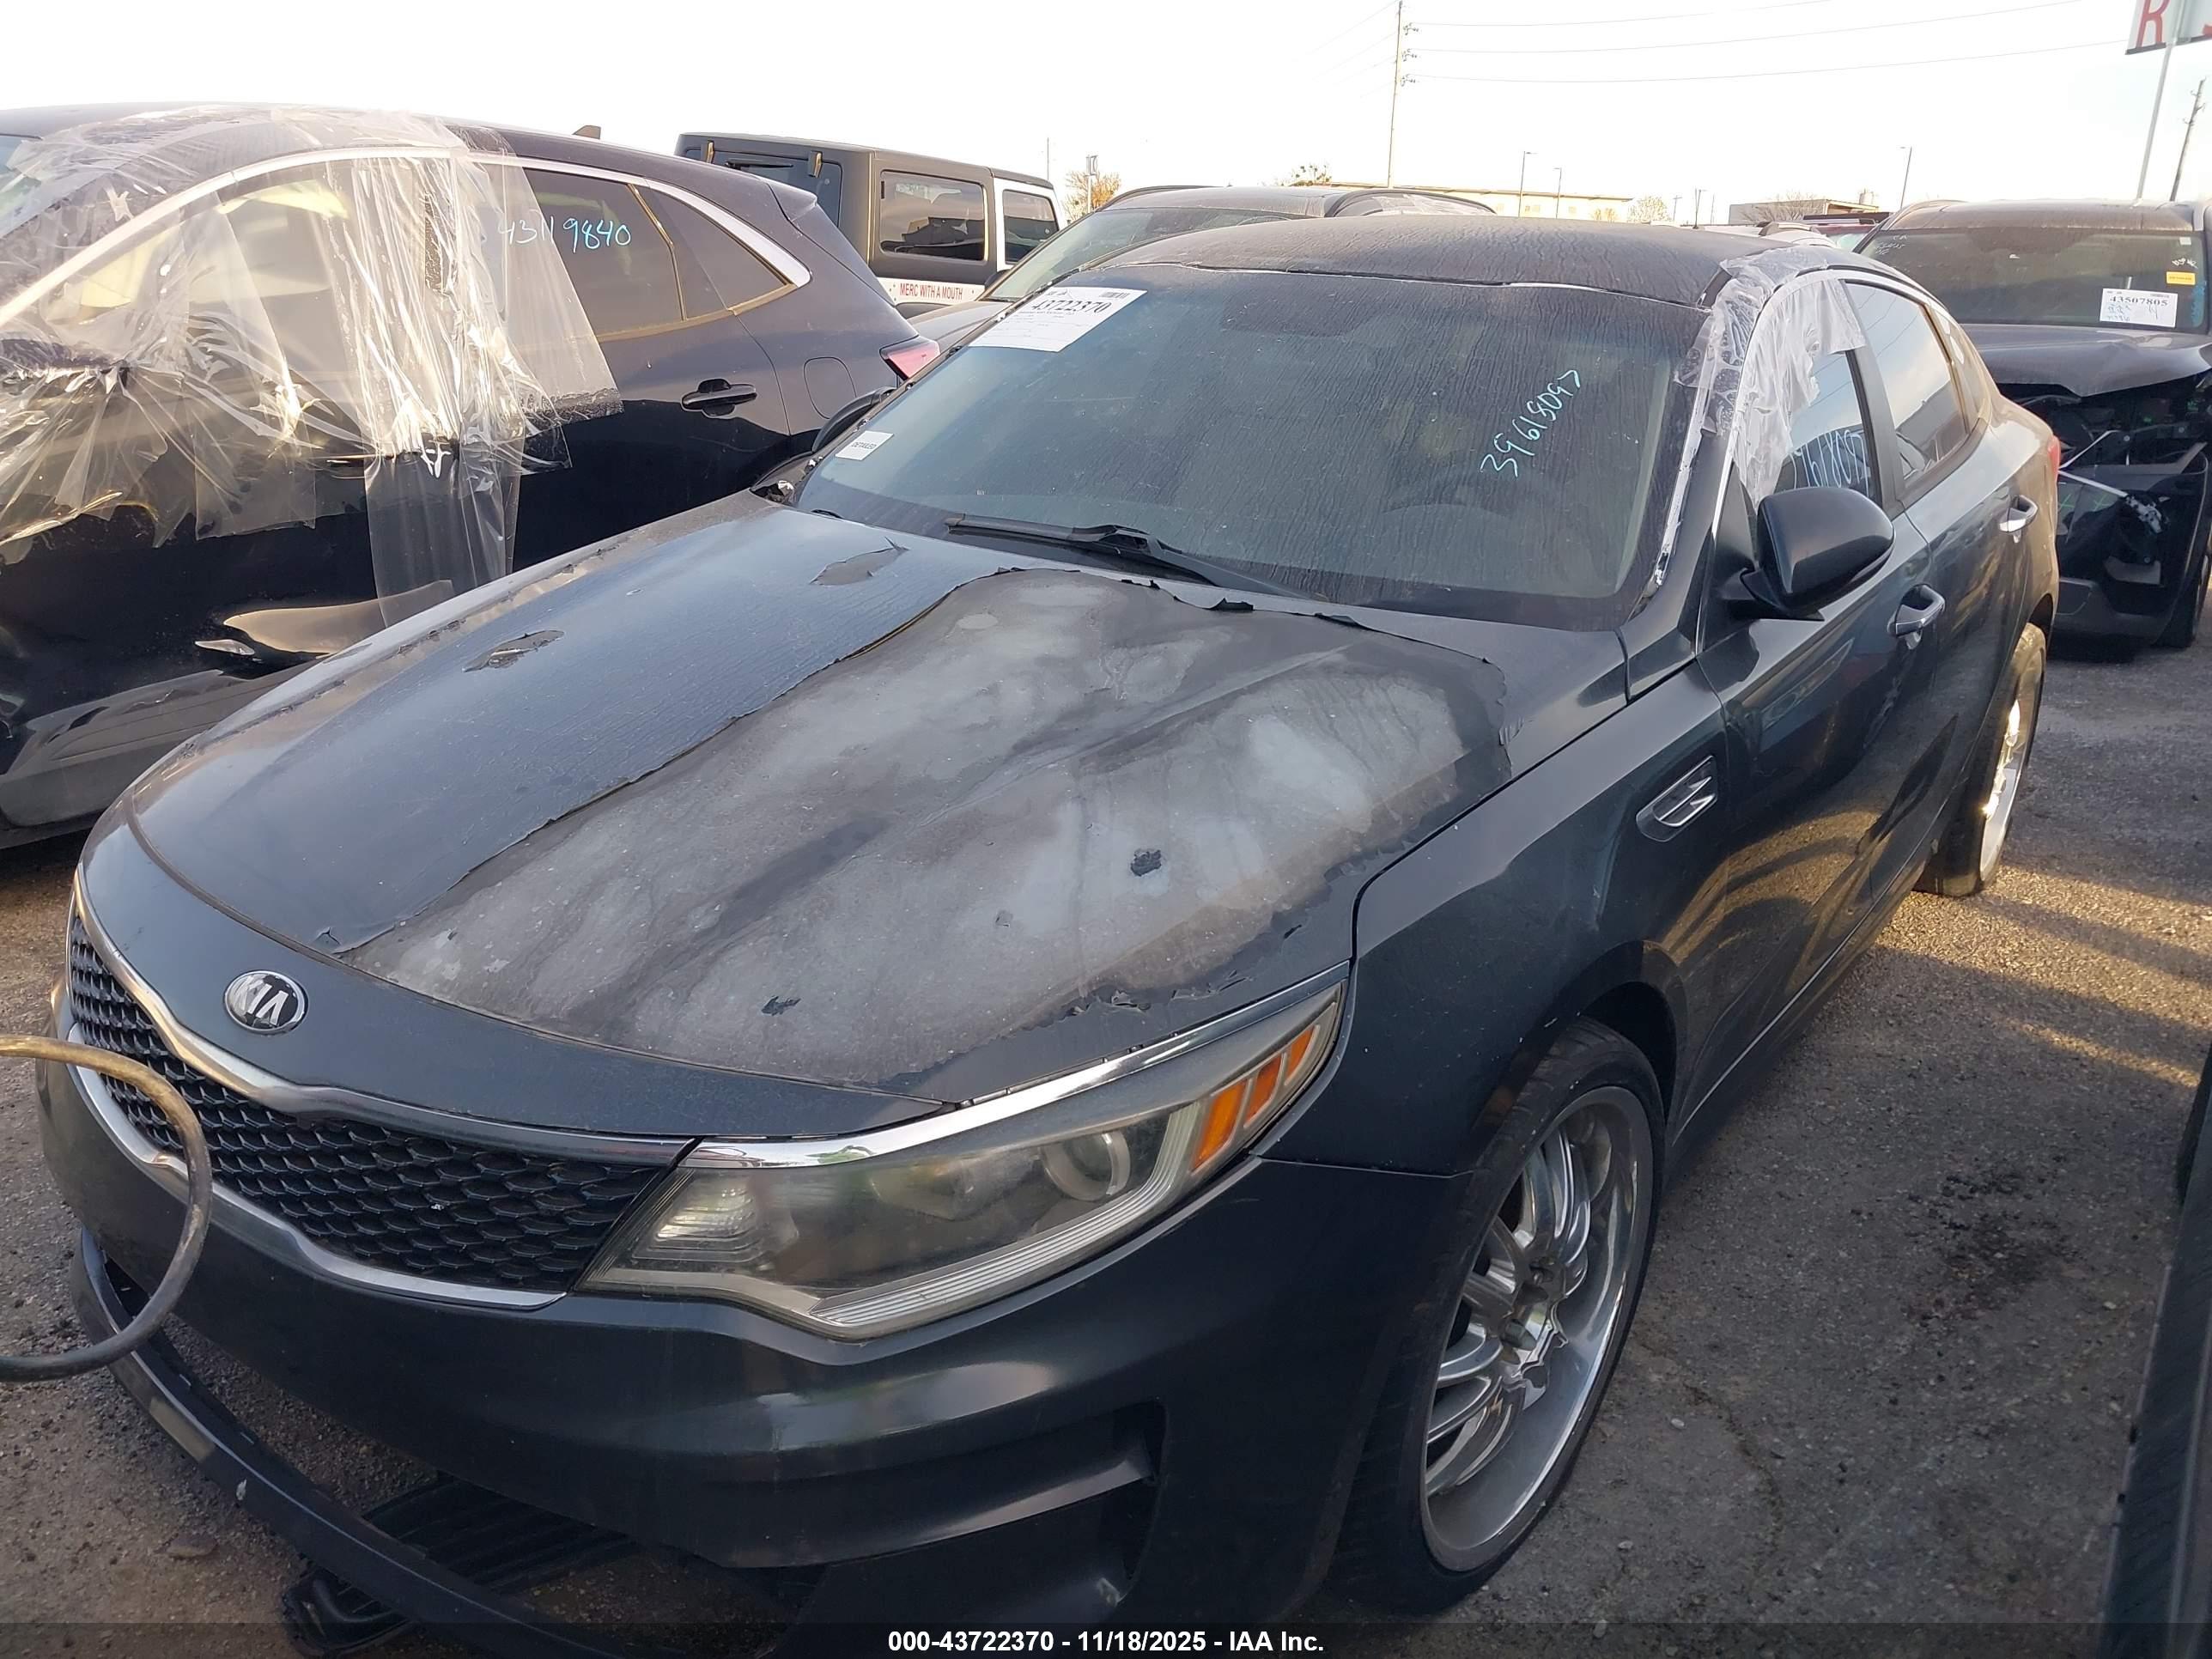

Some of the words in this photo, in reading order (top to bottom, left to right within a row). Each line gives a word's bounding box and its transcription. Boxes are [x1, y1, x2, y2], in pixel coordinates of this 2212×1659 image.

[900, 283, 919, 296] MERC
[920, 284, 935, 298] WITH
[936, 286, 941, 299] A
[942, 287, 963, 301] MOUTH
[1031, 299, 1113, 313] 43722370
[2109, 295, 2169, 307] 43507805
[1479, 369, 1581, 478] 39618097
